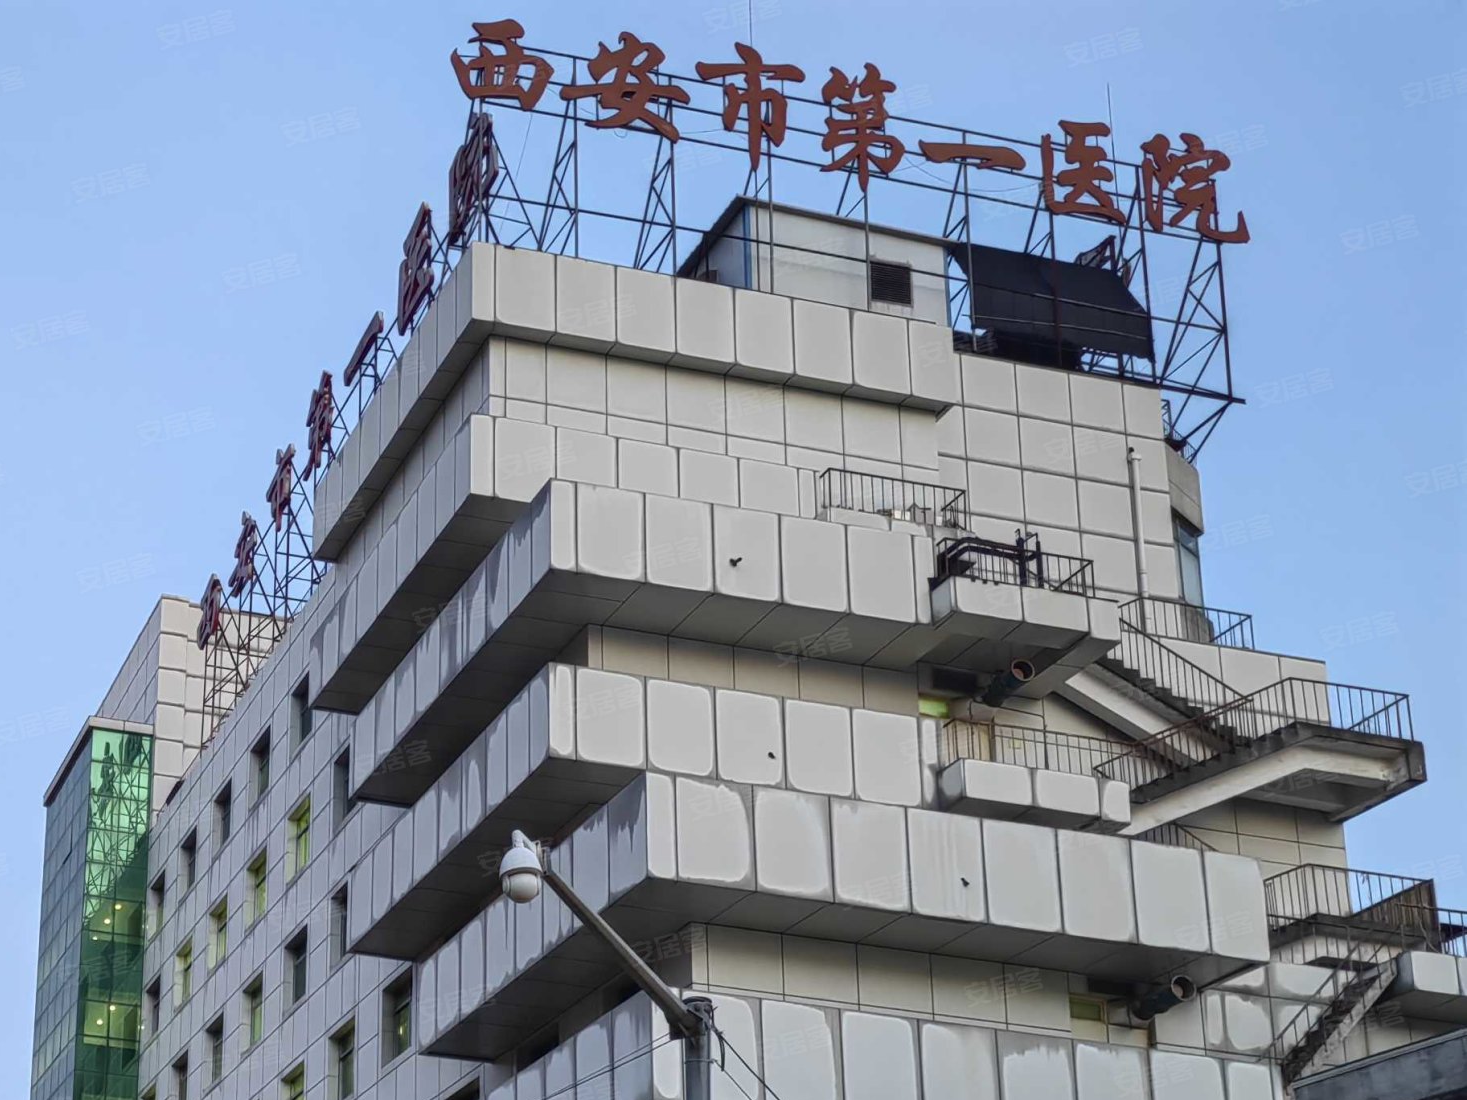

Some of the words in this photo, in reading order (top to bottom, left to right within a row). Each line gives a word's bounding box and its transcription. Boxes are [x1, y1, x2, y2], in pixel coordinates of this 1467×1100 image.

[451, 18, 1250, 244] 西安市第一医院
